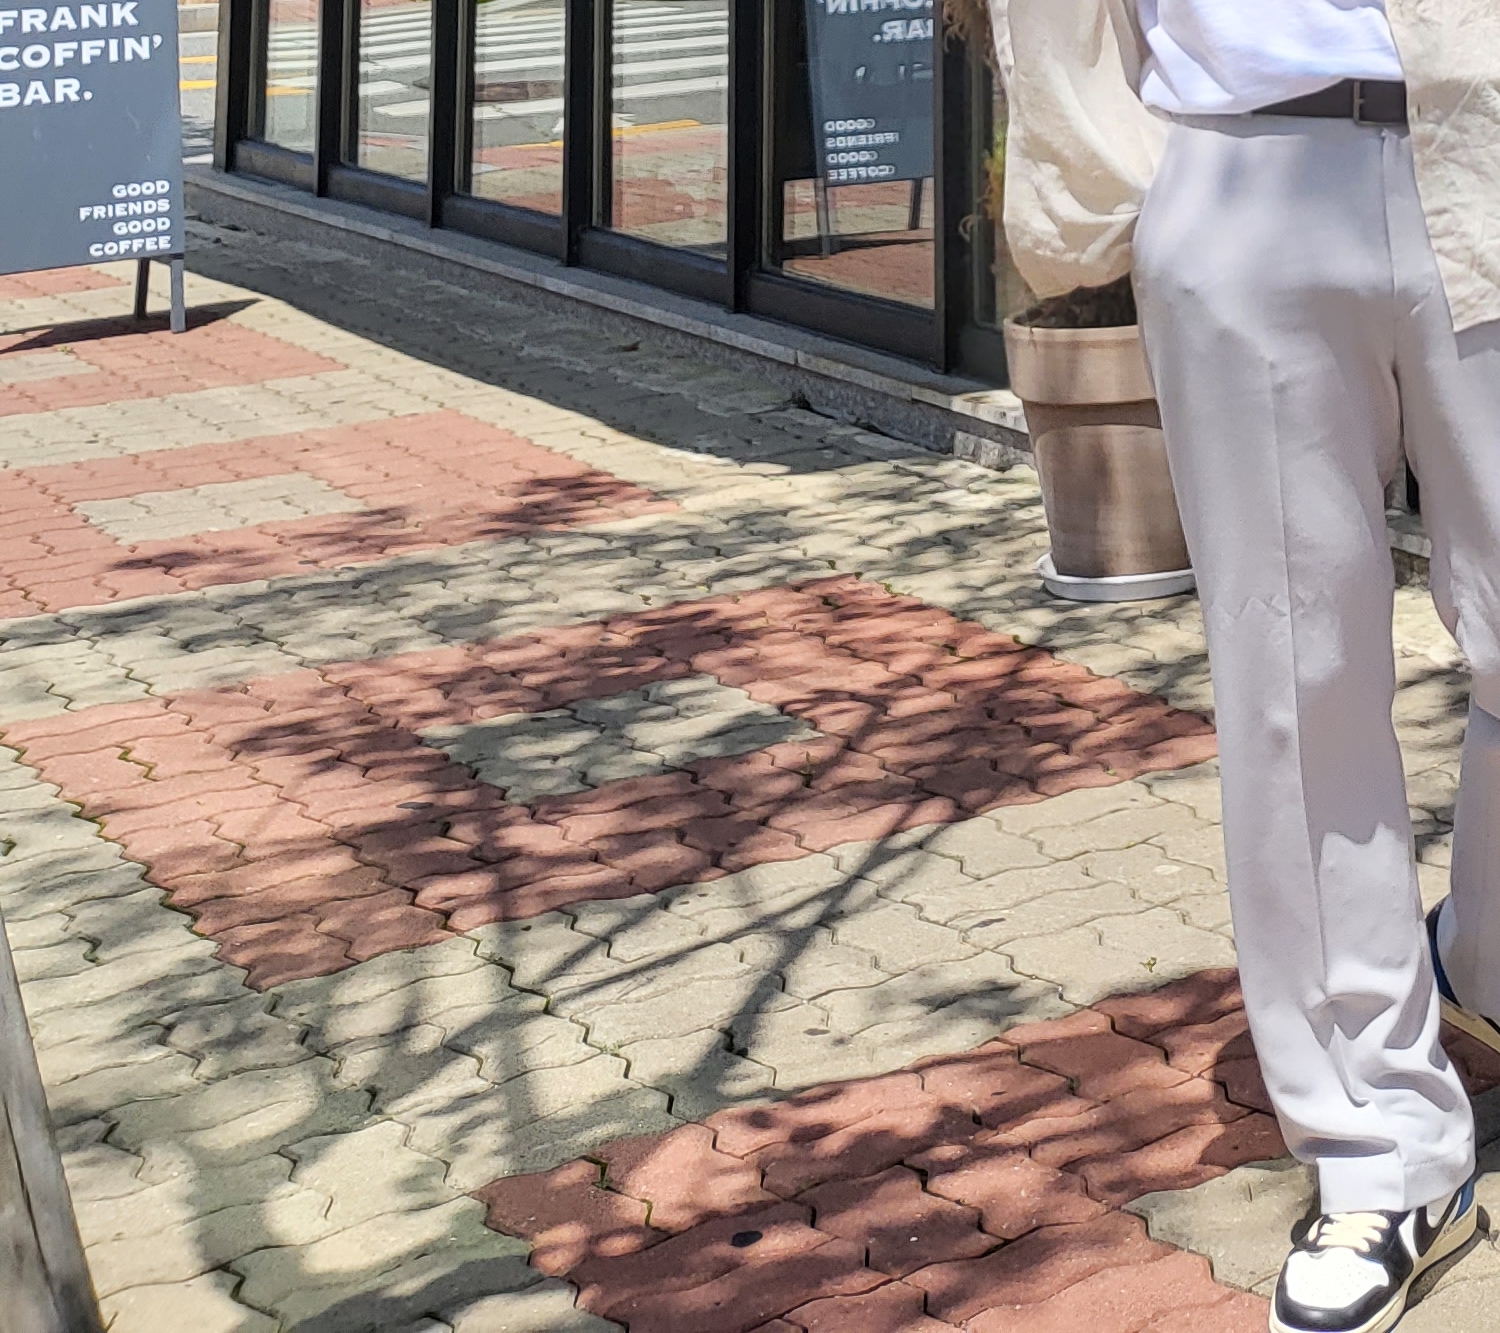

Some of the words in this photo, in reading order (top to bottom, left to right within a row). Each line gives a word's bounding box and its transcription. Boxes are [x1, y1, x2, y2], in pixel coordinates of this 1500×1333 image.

[0, 1, 139, 34] FRANK
[0, 34, 163, 71] COFFIN'
[0, 77, 93, 107] BAR.
[112, 179, 171, 199] GOOD
[79, 199, 171, 222] FRIENDS
[113, 217, 171, 236] GOOD
[89, 236, 172, 257] COFFEE
